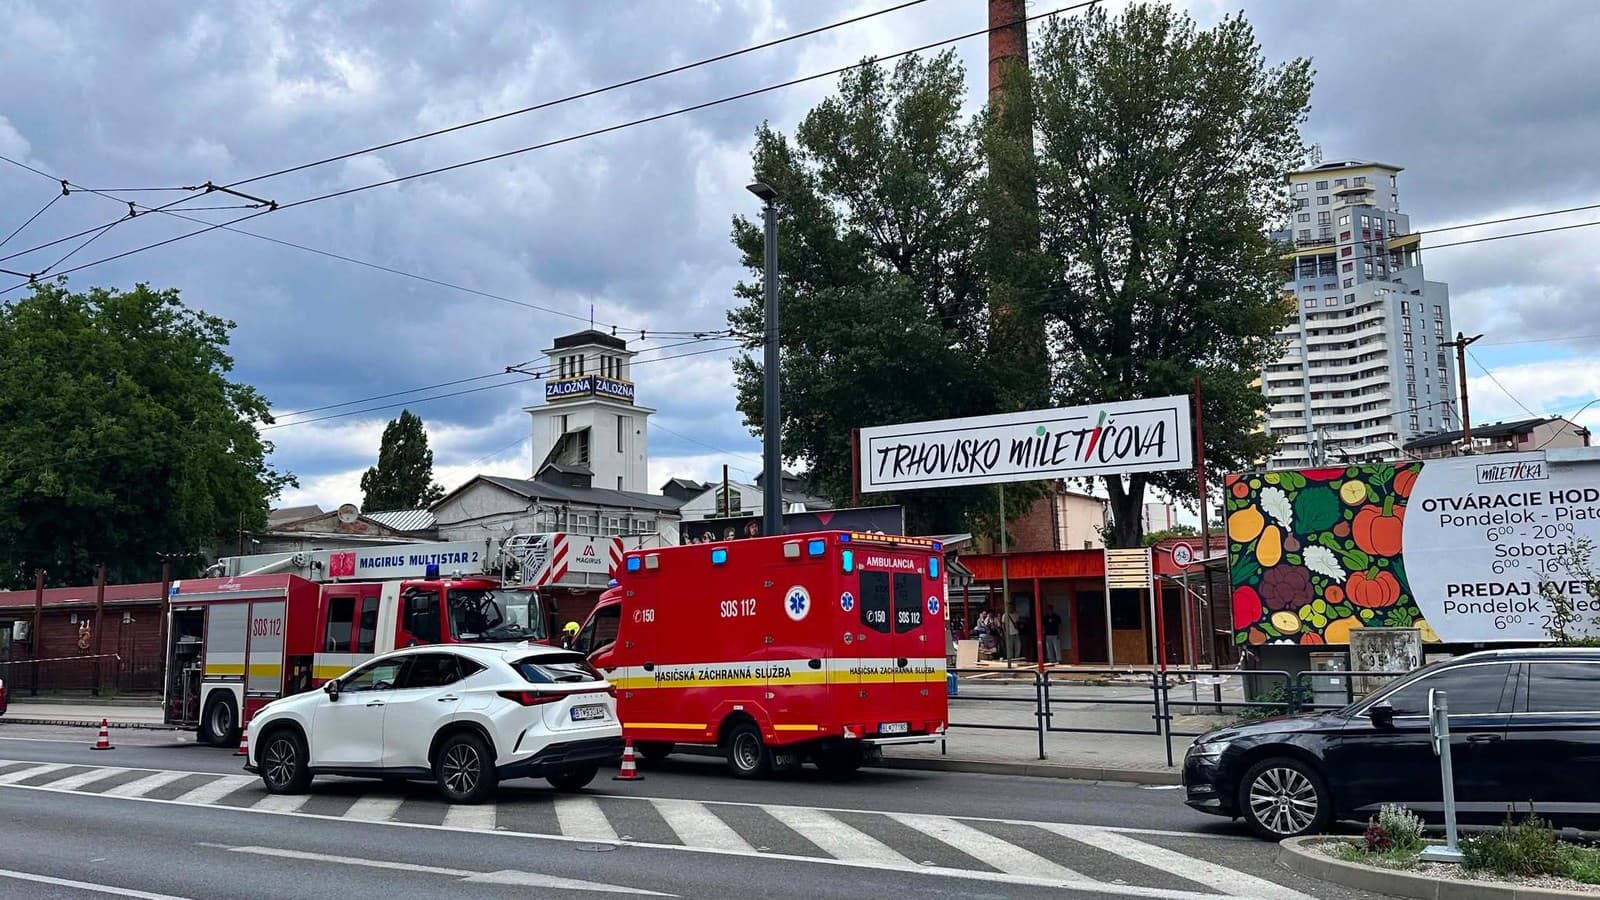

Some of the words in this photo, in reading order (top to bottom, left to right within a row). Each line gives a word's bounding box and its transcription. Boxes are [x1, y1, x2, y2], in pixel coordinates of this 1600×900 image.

[877, 438, 1001, 478] TRHOVISKO
[1421, 492, 1543, 512] OTVÁRACIE
[1440, 508, 1536, 527] Pondelok
[1495, 542, 1568, 557] Sobota
[360, 555, 405, 569] MAGIRUS
[409, 552, 469, 566] MULTISTAR
[472, 551, 479, 562] 2
[866, 556, 915, 569] AMBULANCIA
[1447, 581, 1531, 598] PREDAJ
[720, 600, 738, 618] SOS
[740, 598, 756, 617] 112
[1444, 598, 1540, 614] Pondelok
[642, 609, 655, 622] 150
[874, 610, 886, 623] 150
[898, 611, 910, 623] SOS
[910, 612, 921, 624] 112
[253, 618, 268, 637] SOS
[269, 618, 281, 636] 112
[654, 668, 696, 682] HASIČSKÁ
[698, 666, 752, 680] ZÁCHRANNÁ
[755, 664, 791, 679] SLUŽBA
